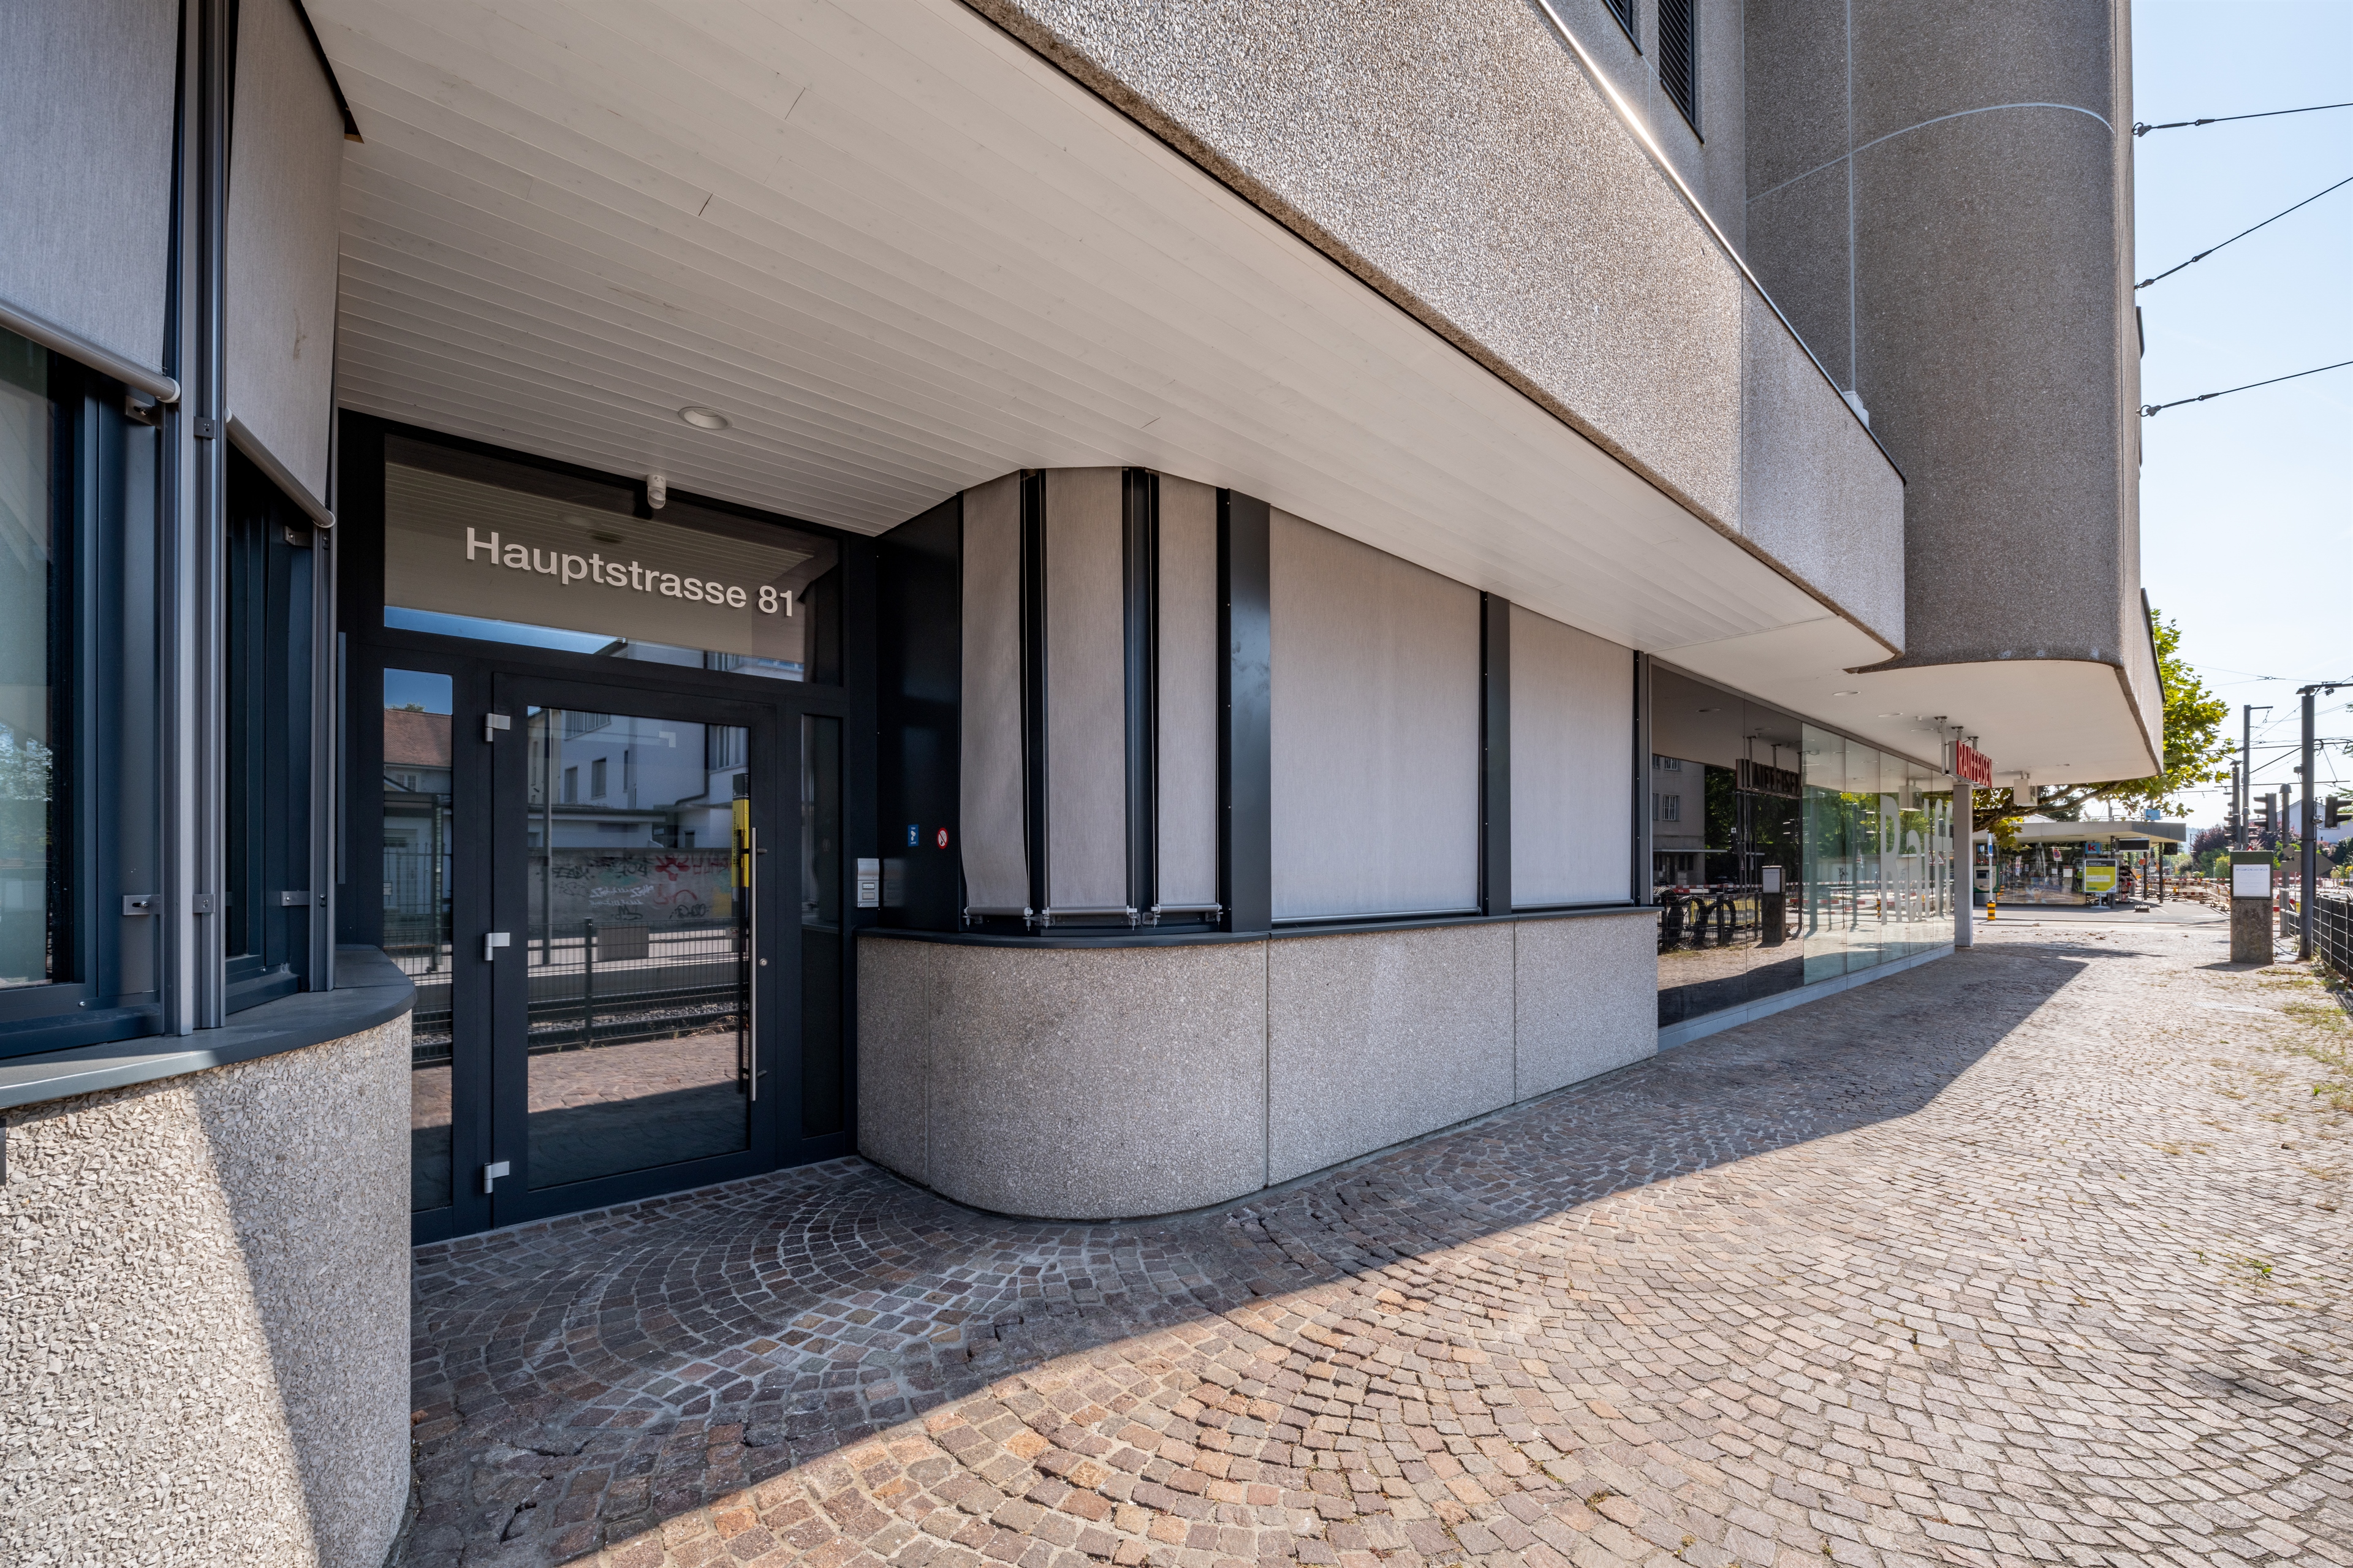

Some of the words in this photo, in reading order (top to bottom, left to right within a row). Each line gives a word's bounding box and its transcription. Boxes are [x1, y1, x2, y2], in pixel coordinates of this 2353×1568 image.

[466, 527, 747, 608] Hauptstrasse
[757, 585, 793, 617] 81
[1957, 740, 1992, 788] RAIFFEISEN
